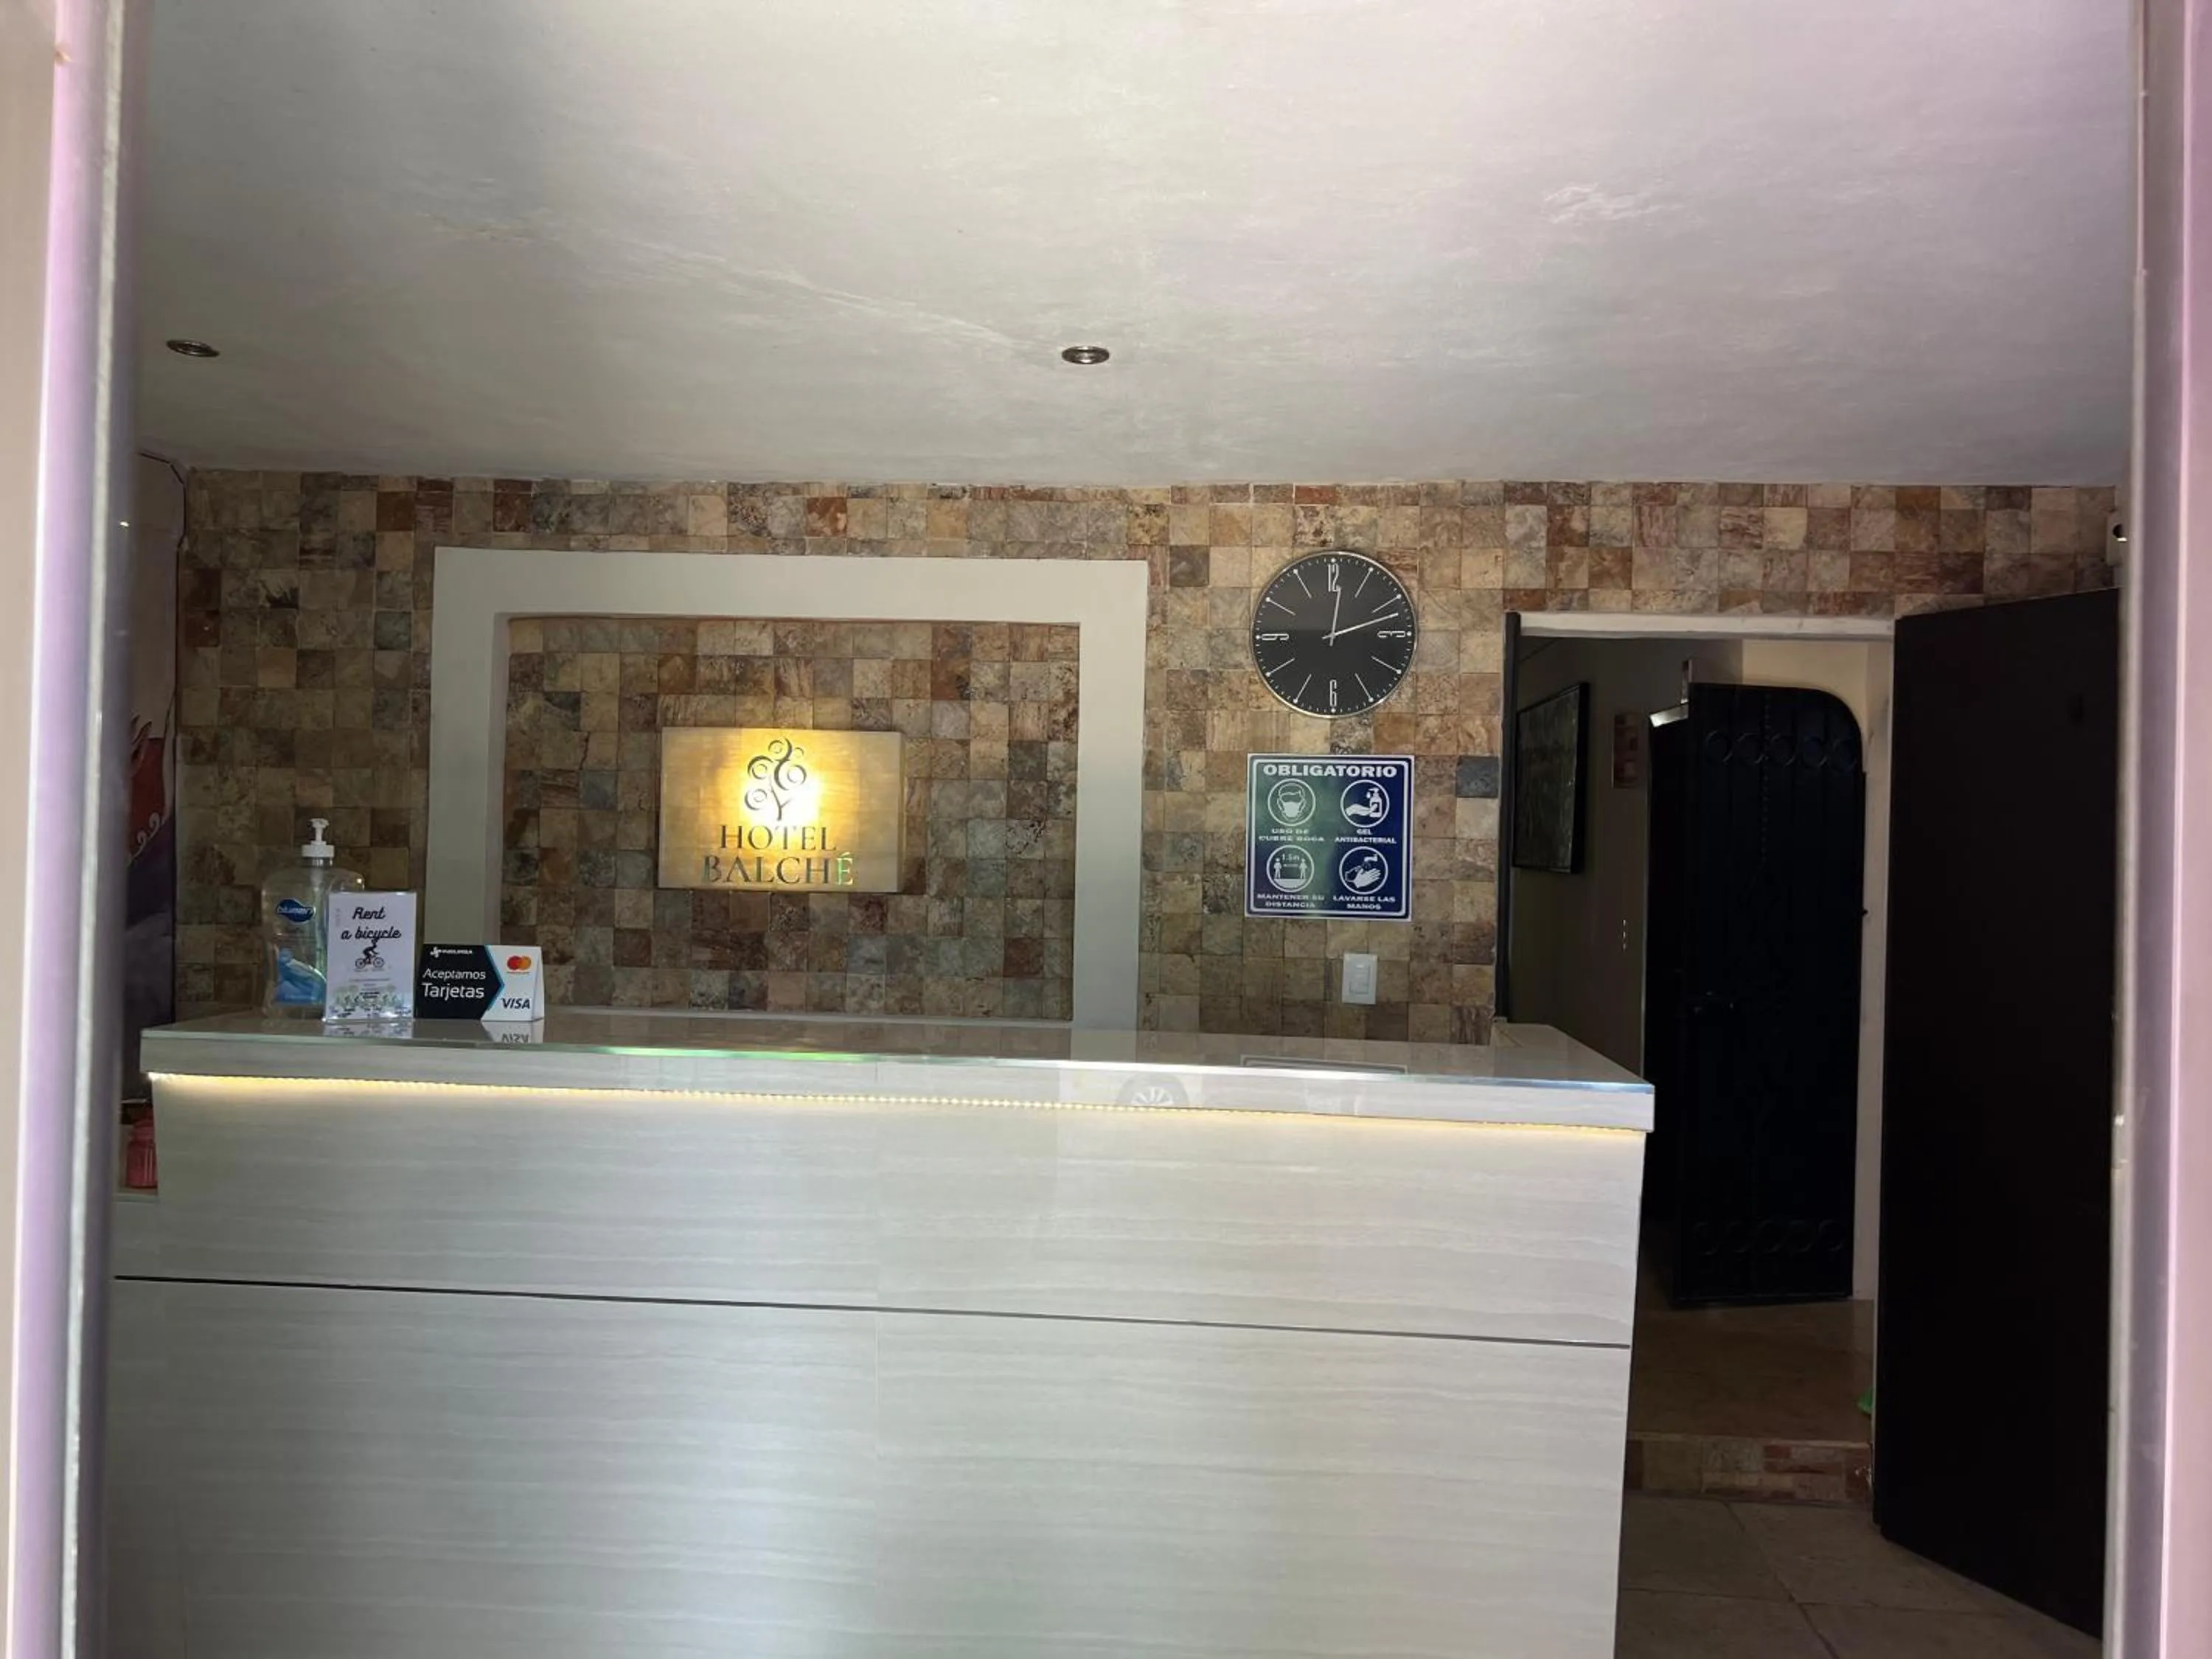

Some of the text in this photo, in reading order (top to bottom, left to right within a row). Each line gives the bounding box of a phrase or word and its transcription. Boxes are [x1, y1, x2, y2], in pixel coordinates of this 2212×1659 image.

[1328, 563, 1341, 592] 12
[1262, 633, 1290, 641] 9
[1329, 679, 1337, 707] 6
[1263, 764, 1397, 778] OBLIGATORIO
[719, 824, 837, 851] HOTEL
[703, 852, 854, 886] BALCHÉ
[352, 906, 386, 920] Rent
[341, 926, 403, 943] a bicycle
[422, 967, 487, 981] Aceptamos
[421, 982, 485, 1001] Tarjetas
[502, 998, 531, 1010] VISA
